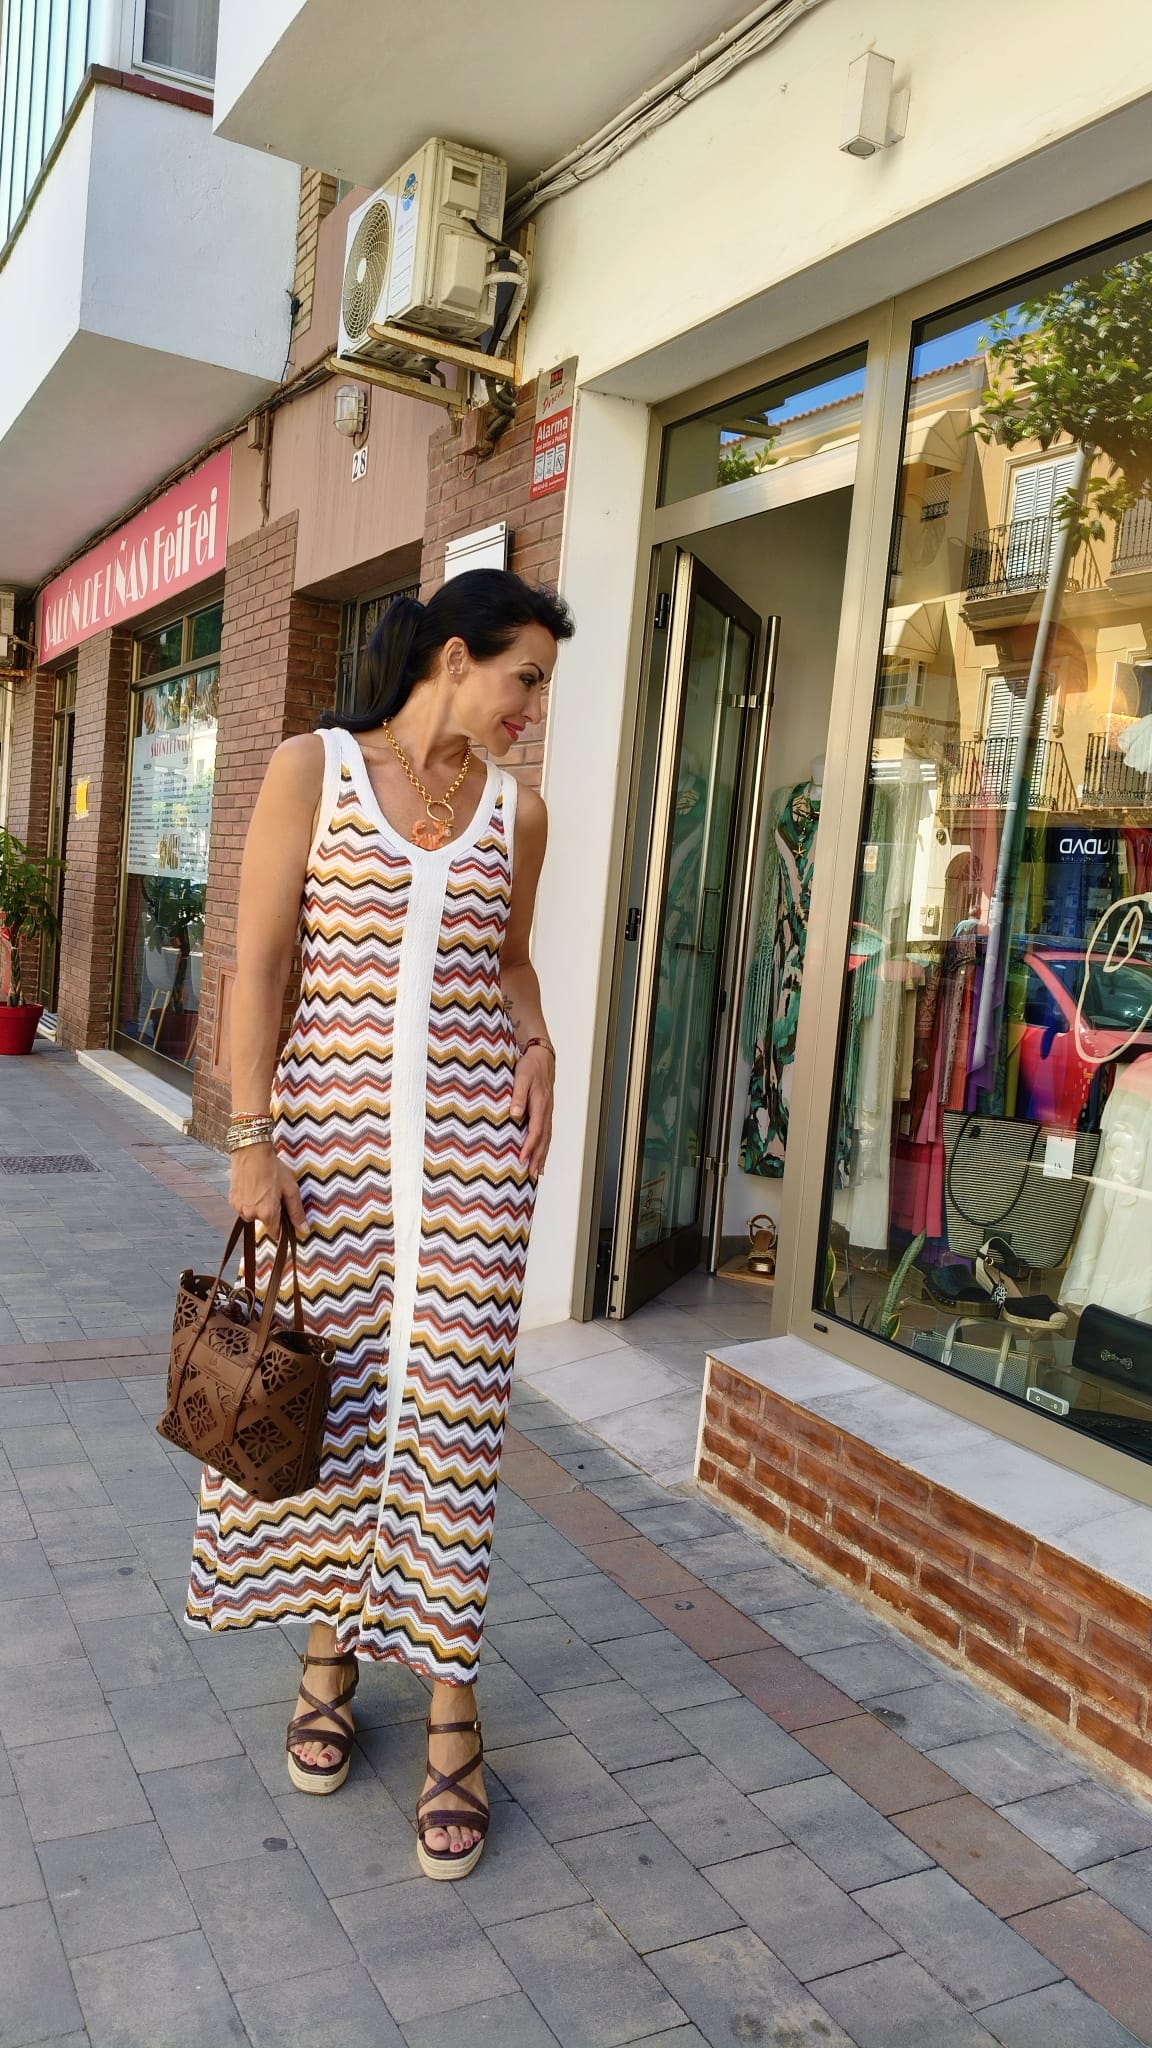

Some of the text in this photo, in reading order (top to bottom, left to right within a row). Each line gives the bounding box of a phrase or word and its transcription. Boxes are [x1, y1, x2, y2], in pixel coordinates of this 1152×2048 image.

[537, 416, 568, 443] Alarma
[352, 450, 366, 479] 28
[44, 486, 217, 653] SALÓN DE UÑAS FeiFei
